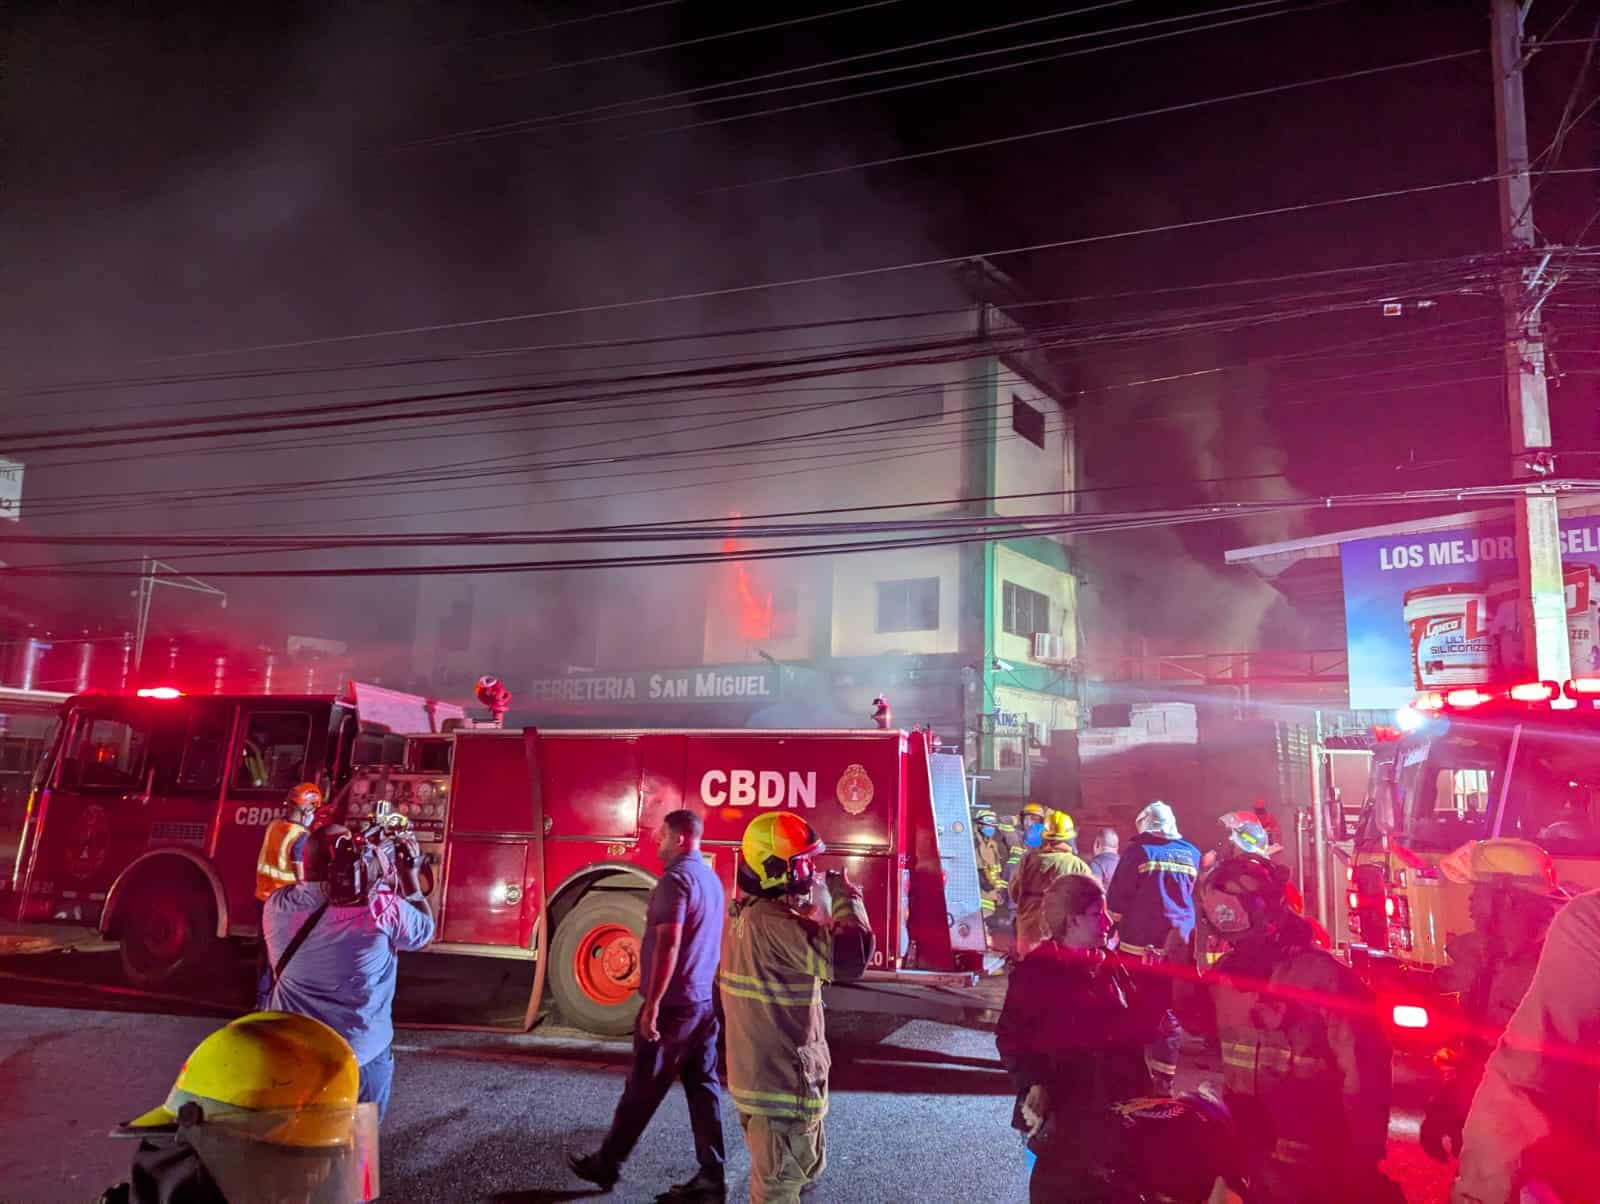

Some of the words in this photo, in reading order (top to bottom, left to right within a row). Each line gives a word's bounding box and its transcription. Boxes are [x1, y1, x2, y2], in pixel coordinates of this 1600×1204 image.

[1379, 545, 1424, 571] LOS
[1428, 536, 1515, 566] MEJOR
[1559, 526, 1600, 554] SEL
[1568, 627, 1590, 640] ZER
[532, 676, 636, 701] FERRETERIA
[649, 673, 688, 698] SAN
[695, 671, 769, 697] MIGUEL
[700, 769, 817, 808] CBDN
